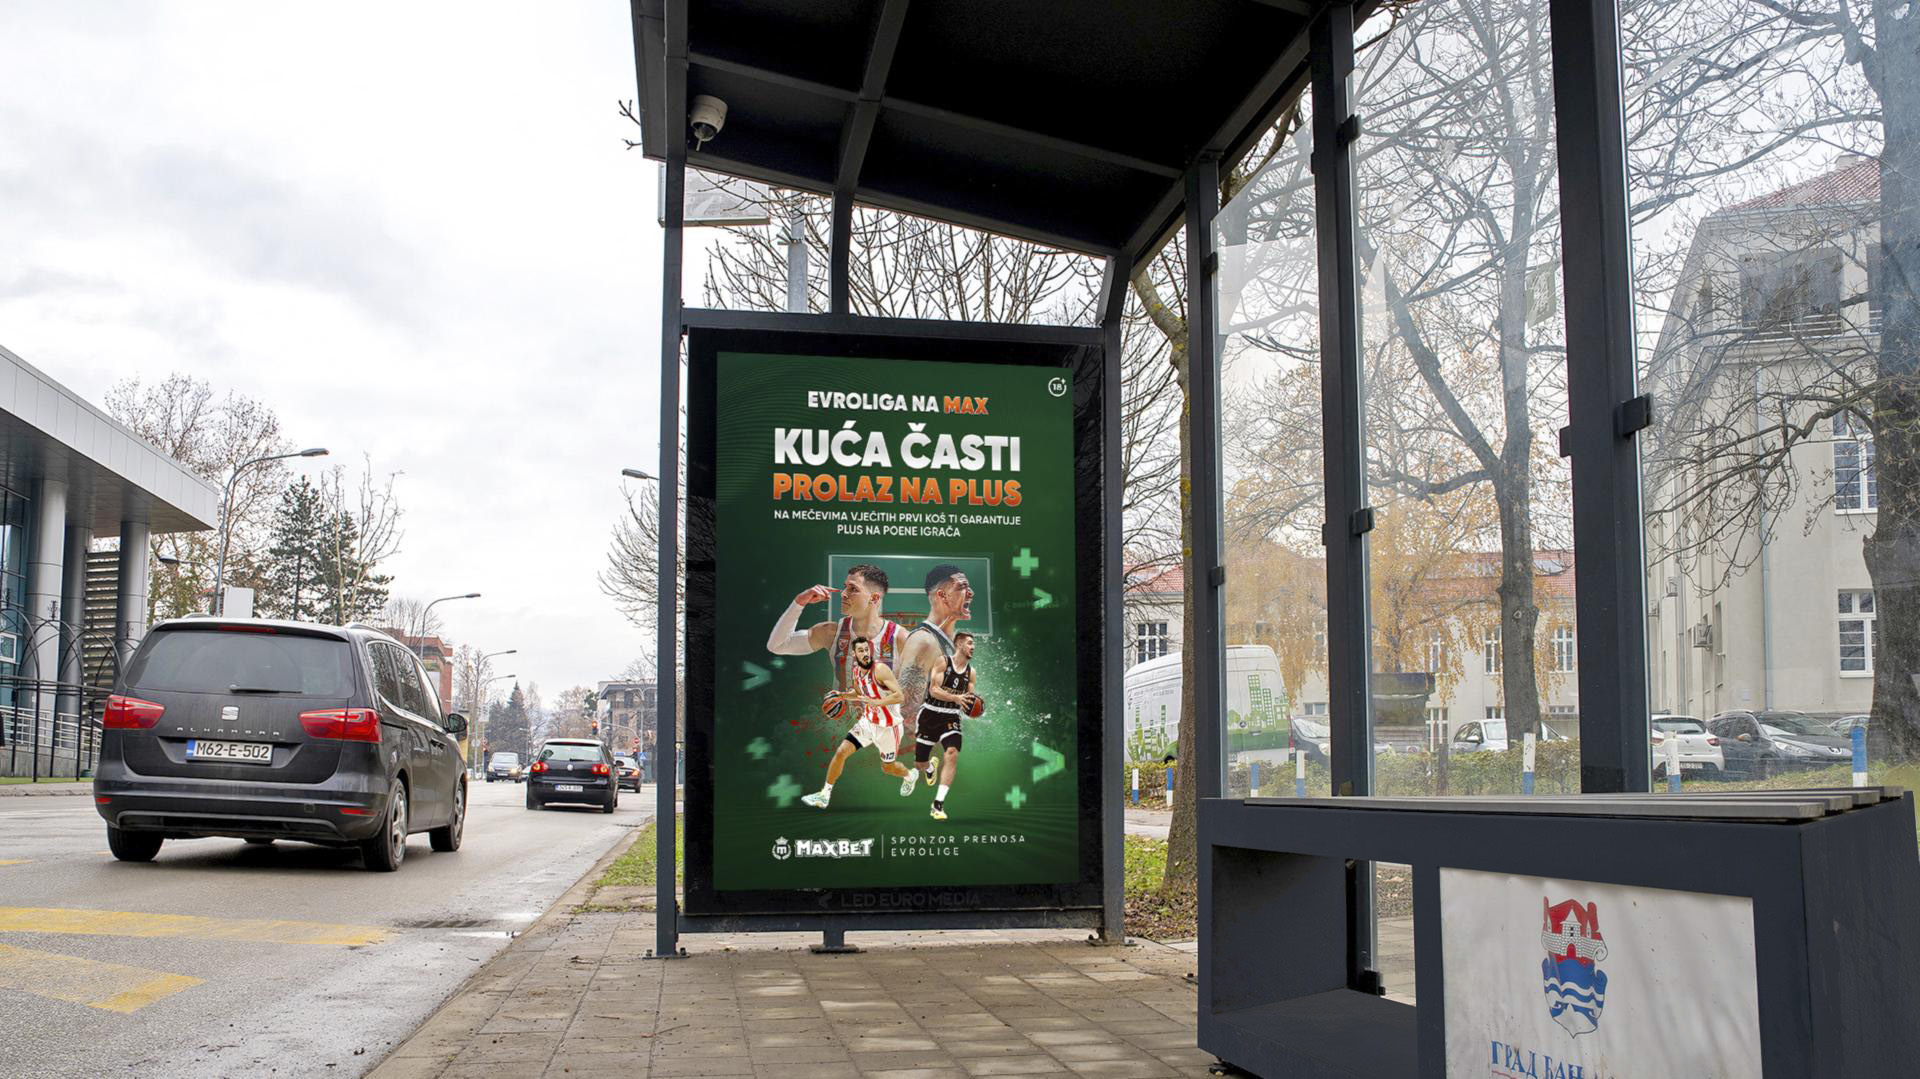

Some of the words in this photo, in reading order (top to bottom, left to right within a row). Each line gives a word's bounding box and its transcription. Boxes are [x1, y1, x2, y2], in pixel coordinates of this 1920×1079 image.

[807, 391, 907, 411] EVROLIGA
[912, 395, 939, 413] NA
[944, 396, 989, 415] MAX
[774, 420, 892, 467] KUĆA
[900, 422, 1021, 472] ČASTI
[773, 473, 894, 503] PROLAZ
[900, 477, 943, 505] NA
[949, 479, 1022, 507] PLUS
[774, 510, 789, 520] NA
[792, 509, 848, 521] MEČEVIMA
[851, 511, 897, 522] VJEČITIH
[899, 513, 923, 523] PRVI
[925, 512, 946, 524] KOŠ
[948, 514, 958, 524] TI
[960, 514, 1021, 526] GARANTUJE
[837, 525, 863, 535] PLUS
[866, 525, 881, 536] NA
[883, 525, 918, 536] POENE
[921, 525, 961, 537] IGRAČA
[197, 742, 270, 759] M62-E-502
[891, 836, 955, 845] SPONZOR
[964, 834, 1025, 844] PRENOSA
[891, 847, 959, 857] EVROLIGE
[841, 894, 876, 908] LED
[880, 893, 925, 907] EURO
[929, 892, 980, 906] MEDIA
